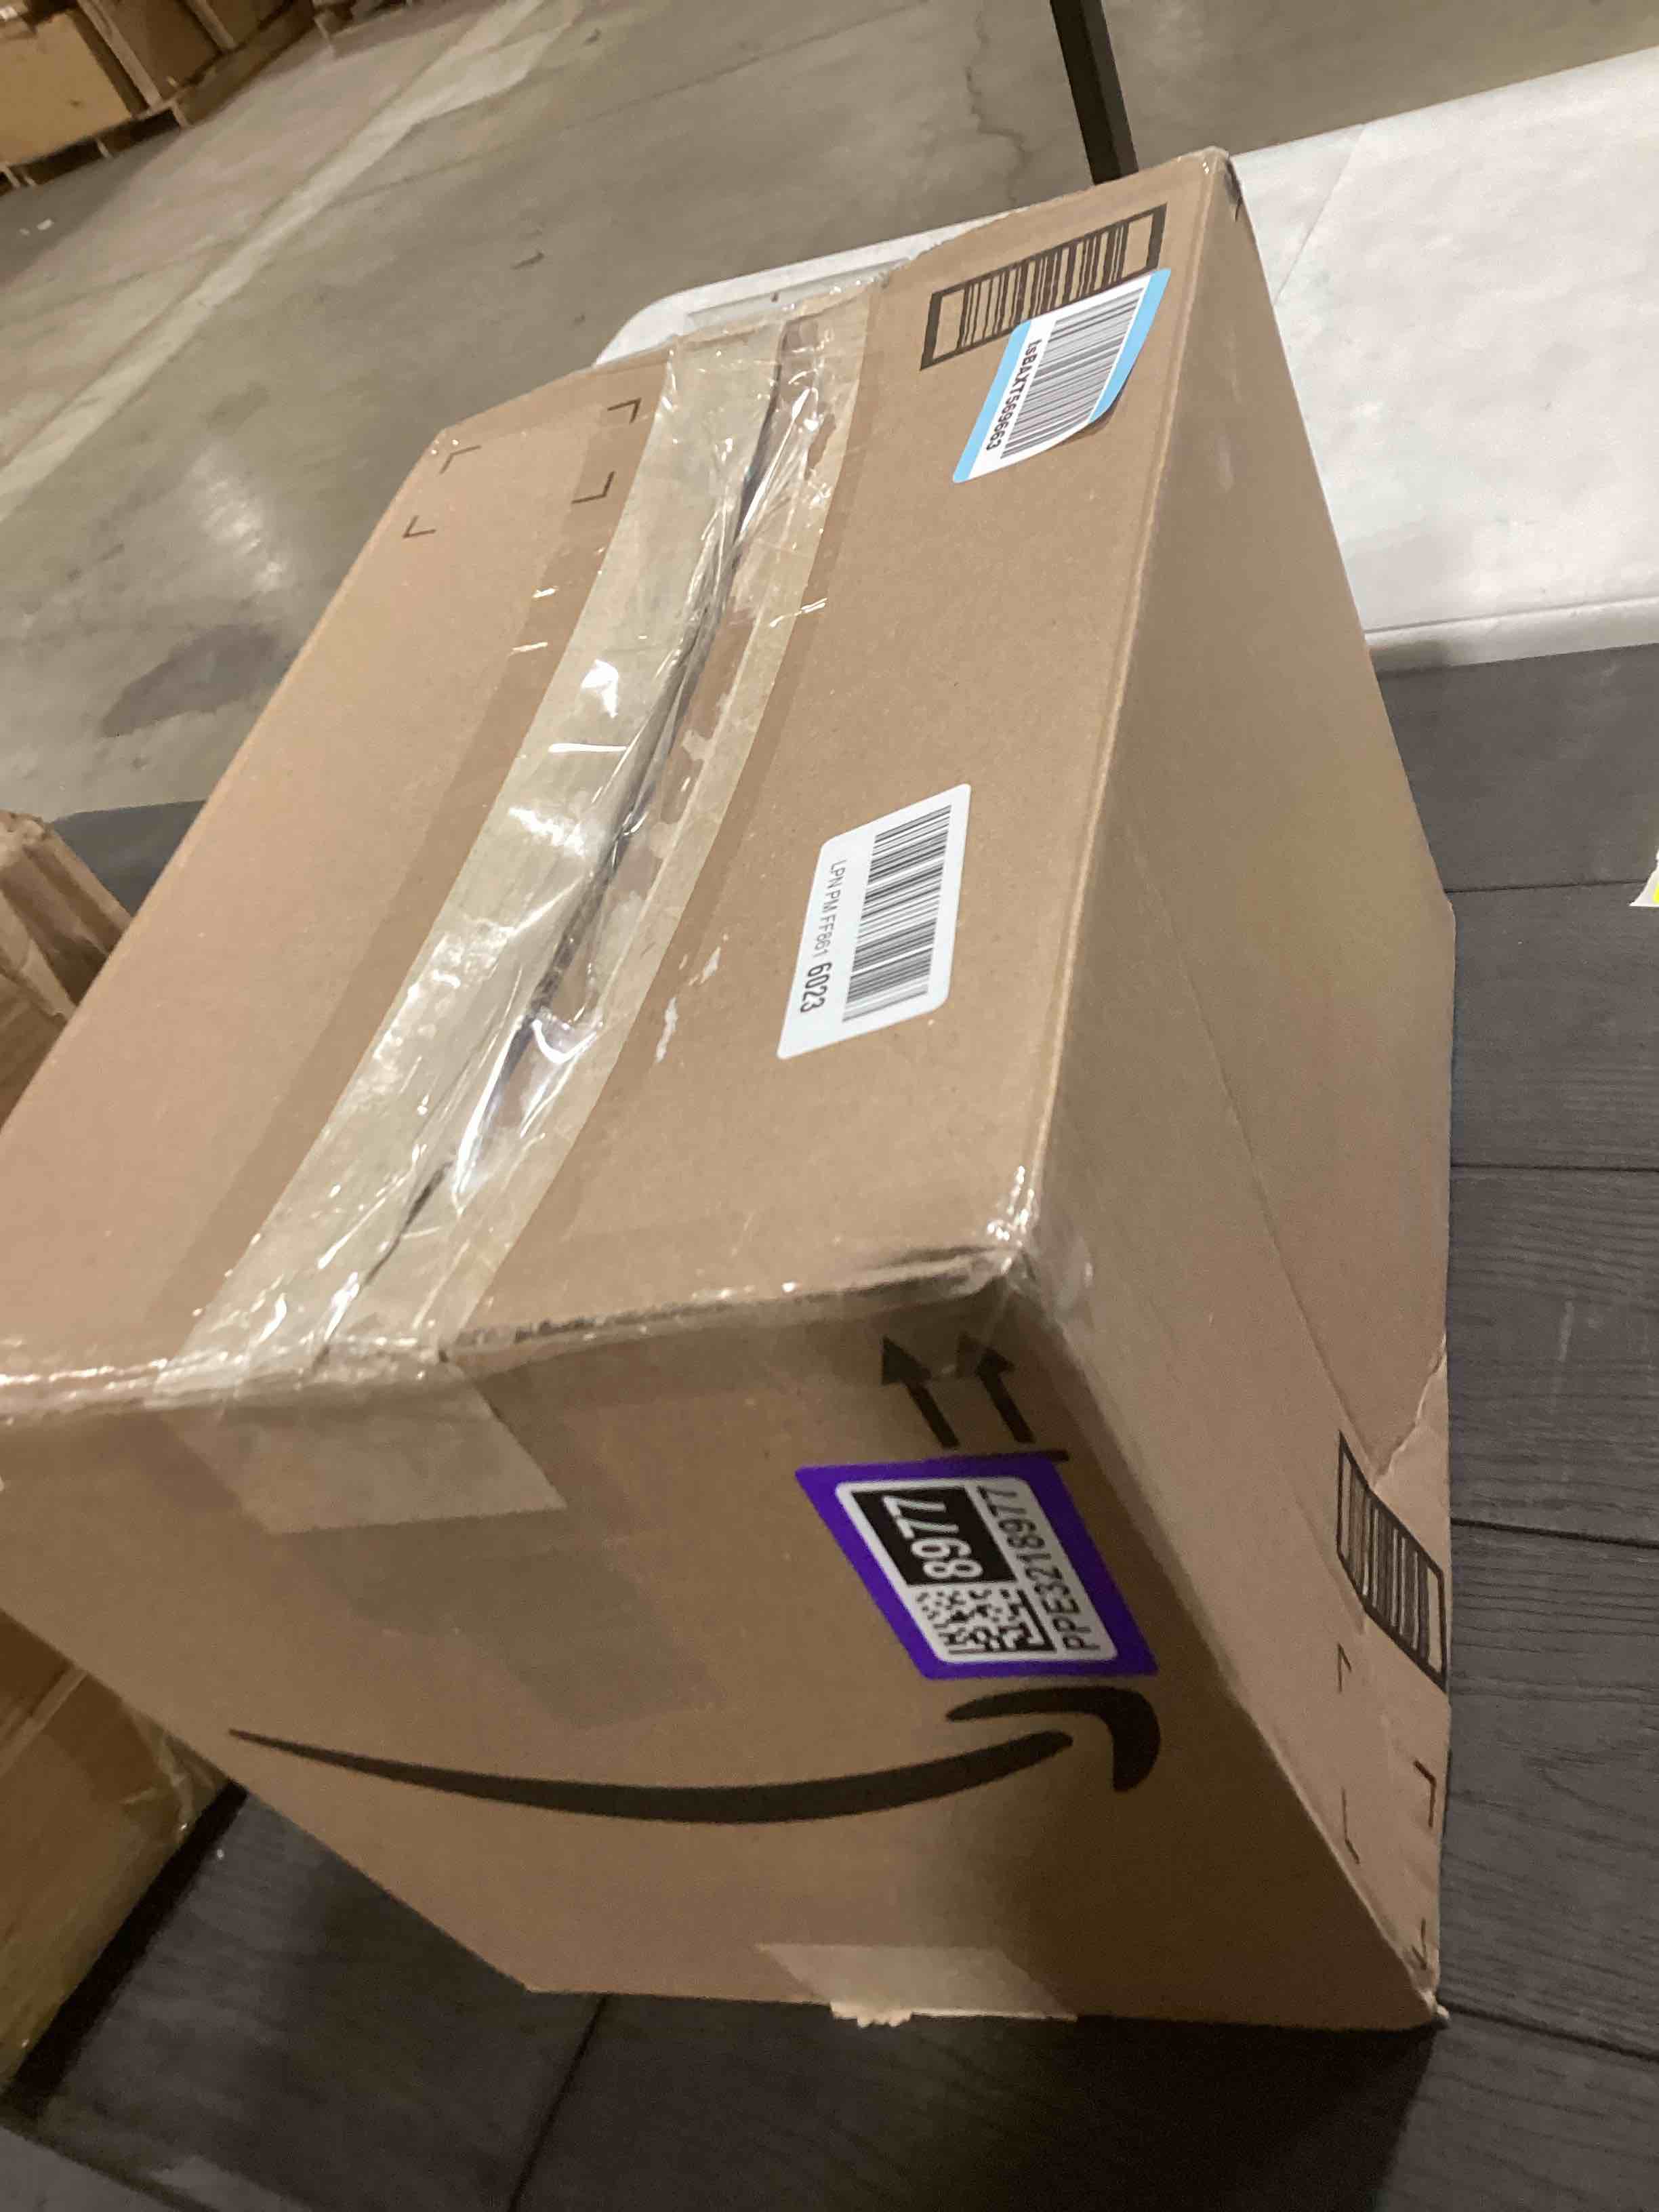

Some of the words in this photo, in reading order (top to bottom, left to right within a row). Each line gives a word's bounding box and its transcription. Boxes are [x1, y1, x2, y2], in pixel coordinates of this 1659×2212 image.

[800, 962, 832, 1012] 6023
[882, 1496, 983, 1578] 8977
[979, 1486, 1100, 1650] PPE3218977
